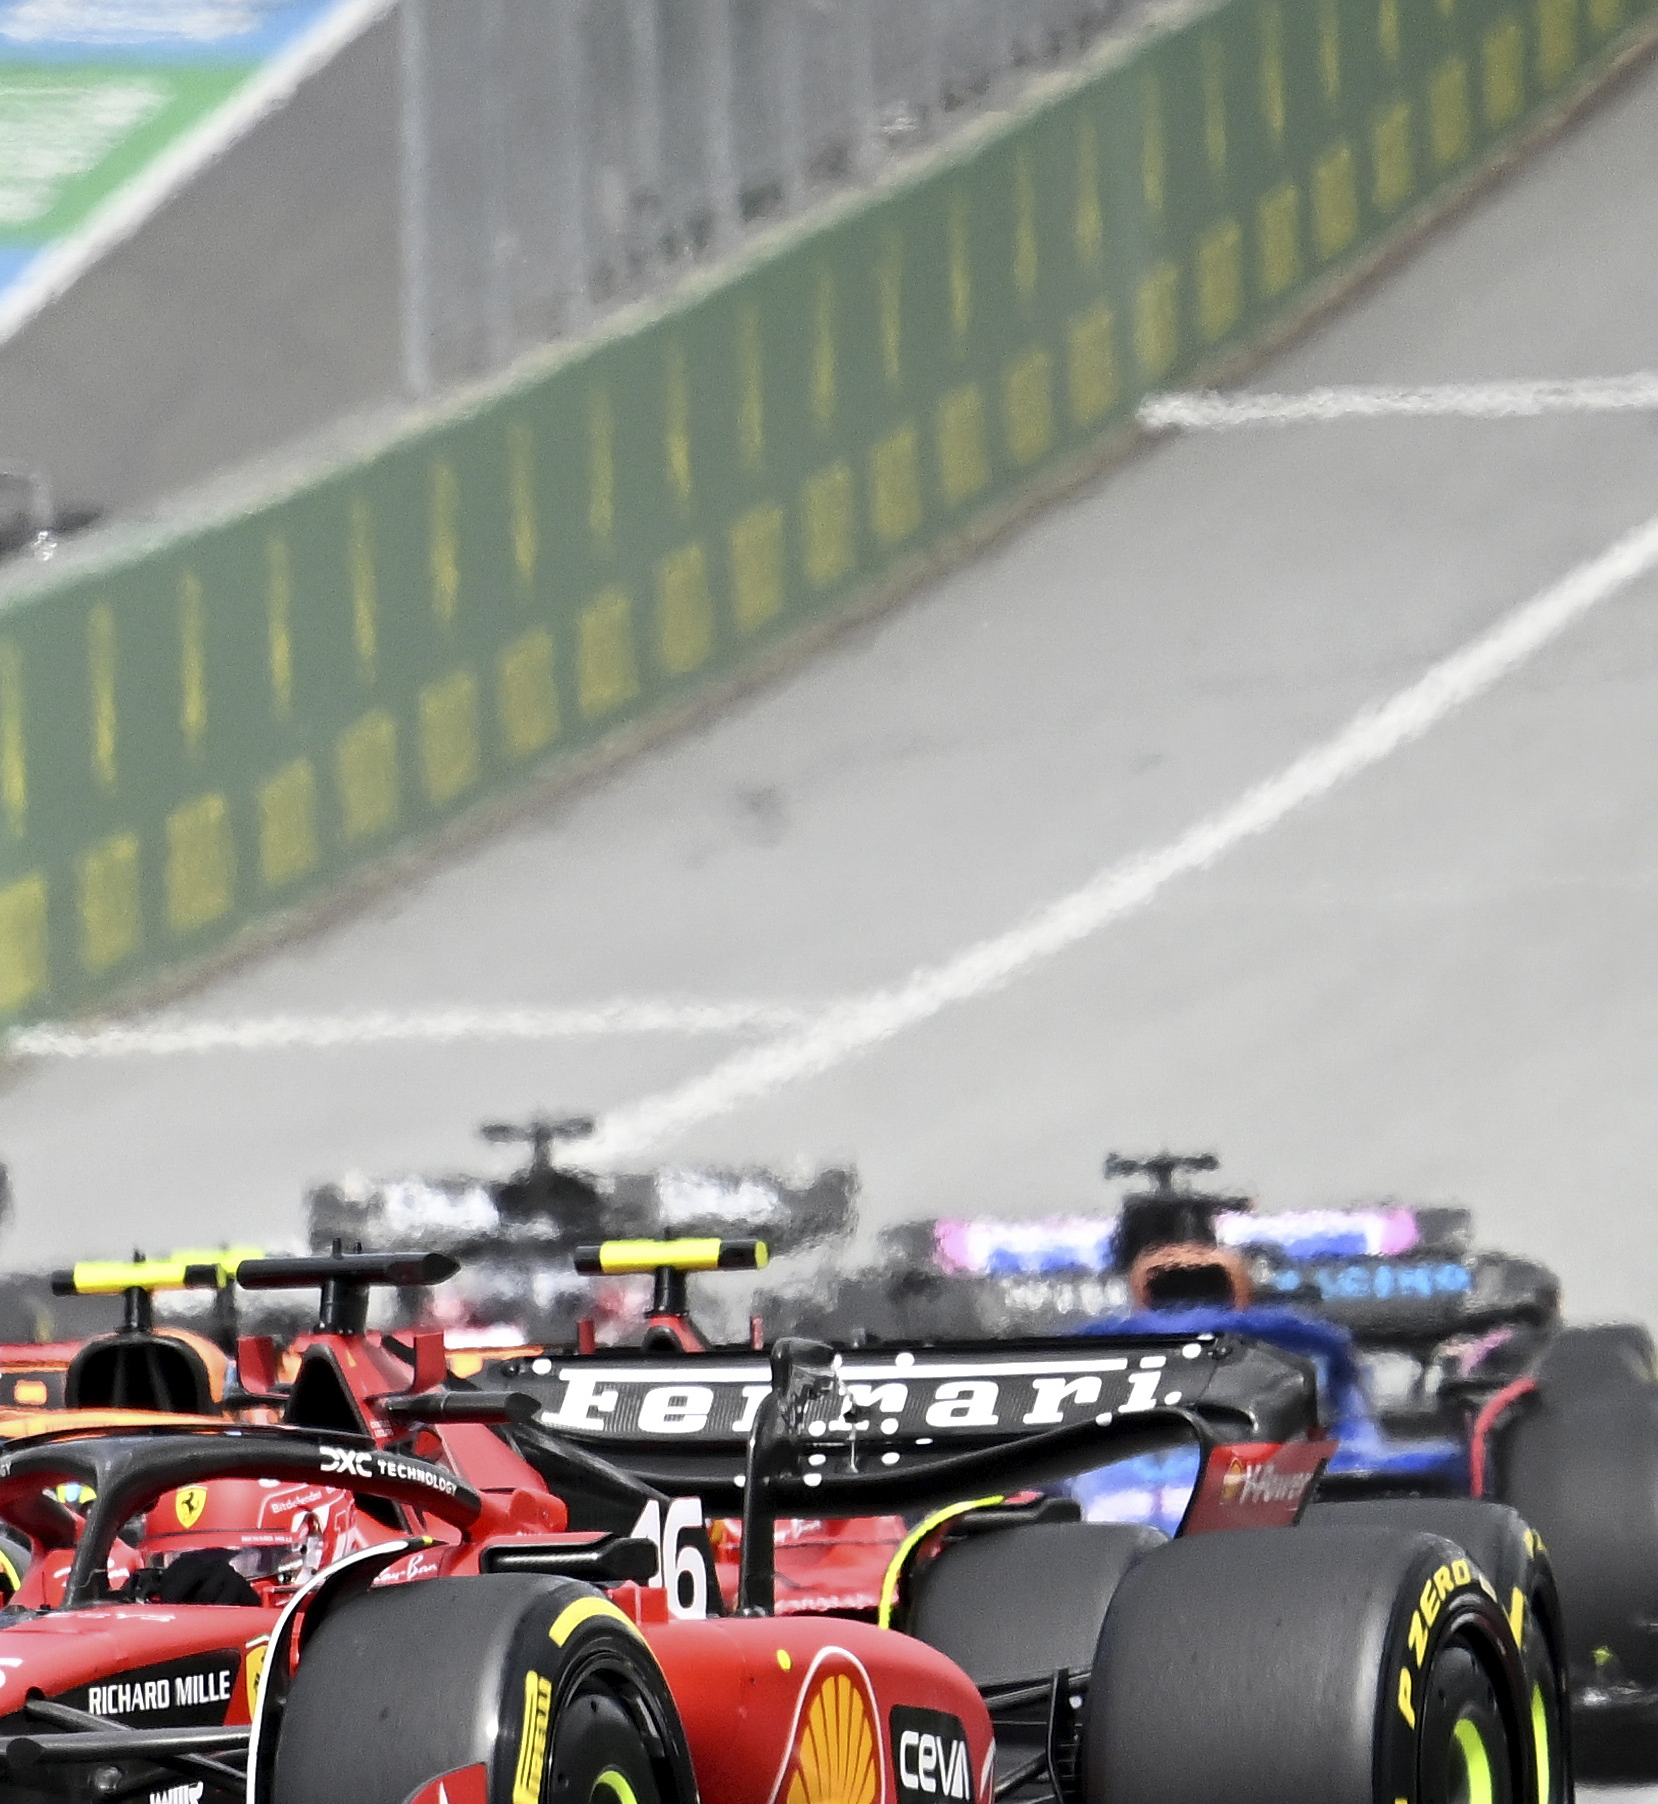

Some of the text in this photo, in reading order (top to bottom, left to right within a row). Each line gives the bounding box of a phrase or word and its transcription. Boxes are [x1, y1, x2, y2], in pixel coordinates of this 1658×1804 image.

[320, 1446, 458, 1497] DXC TECHNOLOGY
[630, 1498, 706, 1620] 16
[1407, 1557, 1472, 1669] ZERO
[89, 1669, 231, 1715] RICHARD MILLE
